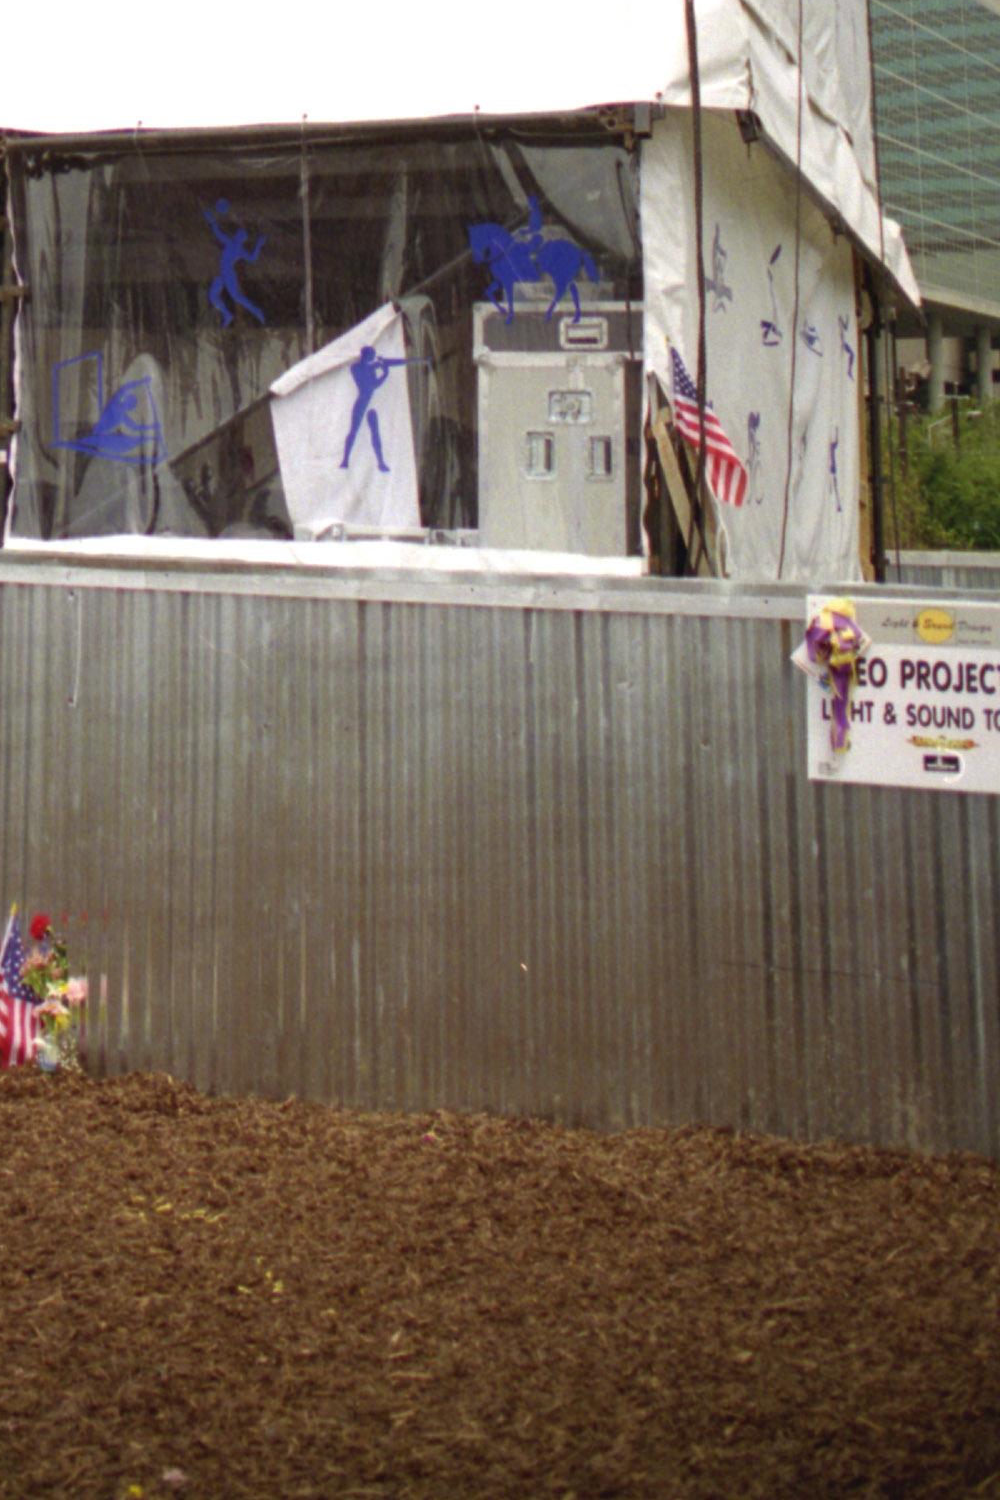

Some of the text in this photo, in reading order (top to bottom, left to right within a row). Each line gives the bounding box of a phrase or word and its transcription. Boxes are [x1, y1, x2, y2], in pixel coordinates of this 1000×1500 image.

[900, 659, 1000, 695] PROJEC
[821, 697, 874, 723] LHT
[883, 702, 897, 725] &
[906, 704, 975, 730] SOUND
